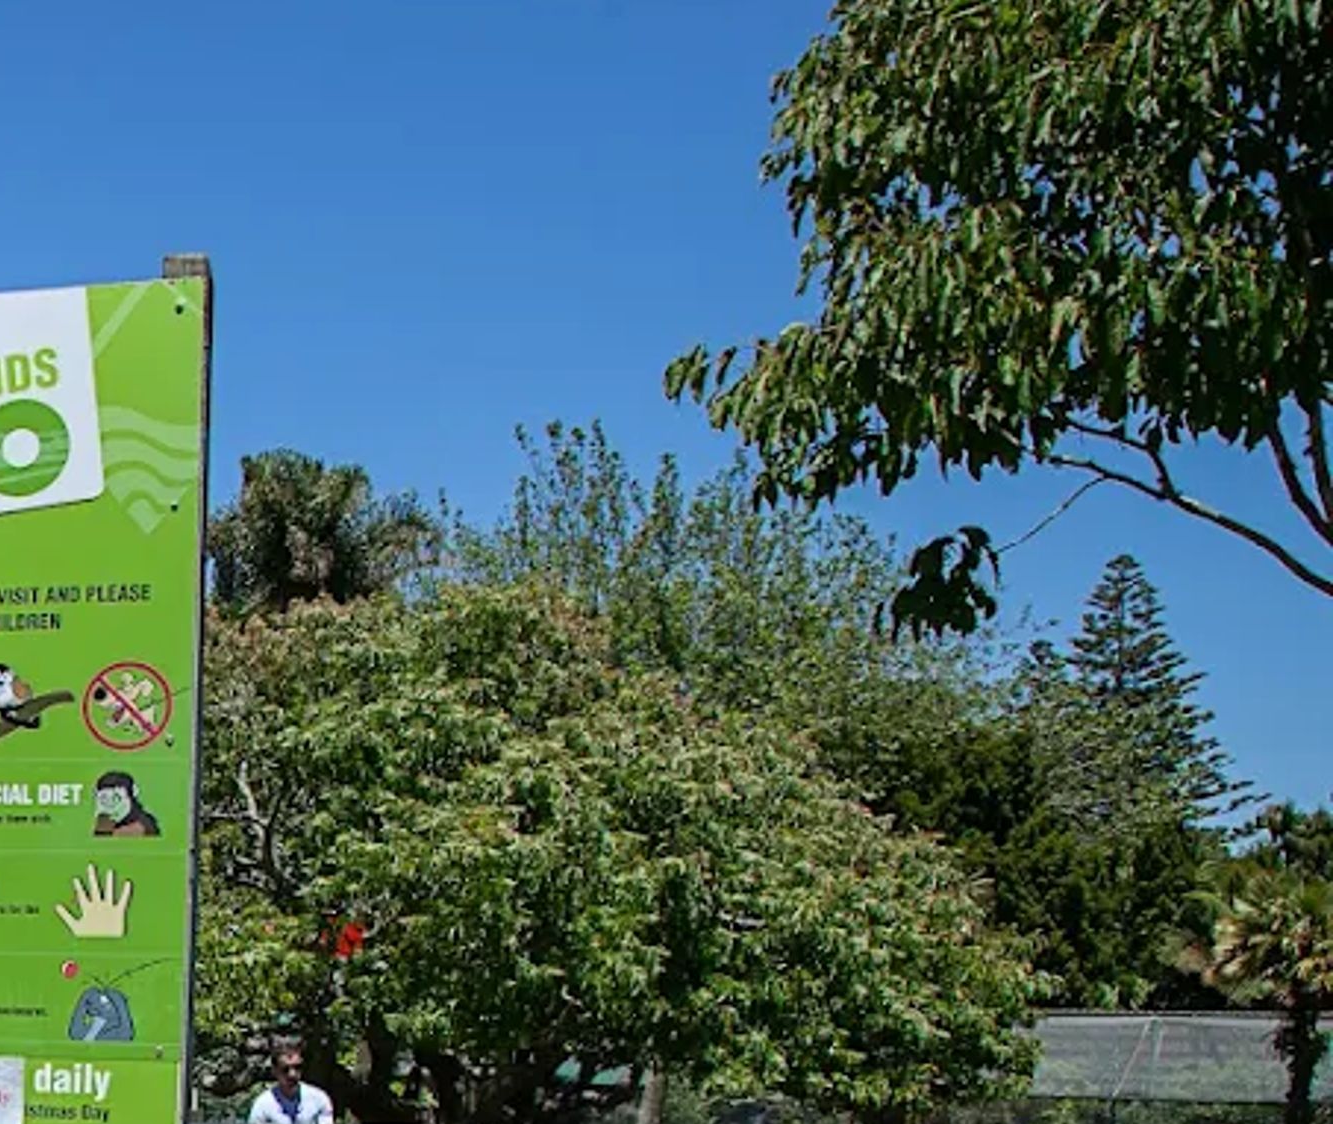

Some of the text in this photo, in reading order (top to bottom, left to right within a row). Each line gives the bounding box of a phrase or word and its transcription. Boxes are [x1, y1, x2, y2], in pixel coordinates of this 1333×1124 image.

[45, 586, 81, 603] AND
[86, 584, 151, 603] PLEASE
[38, 783, 83, 806] DIET
[34, 1062, 111, 1102] daily
[82, 1104, 110, 1122] Day
